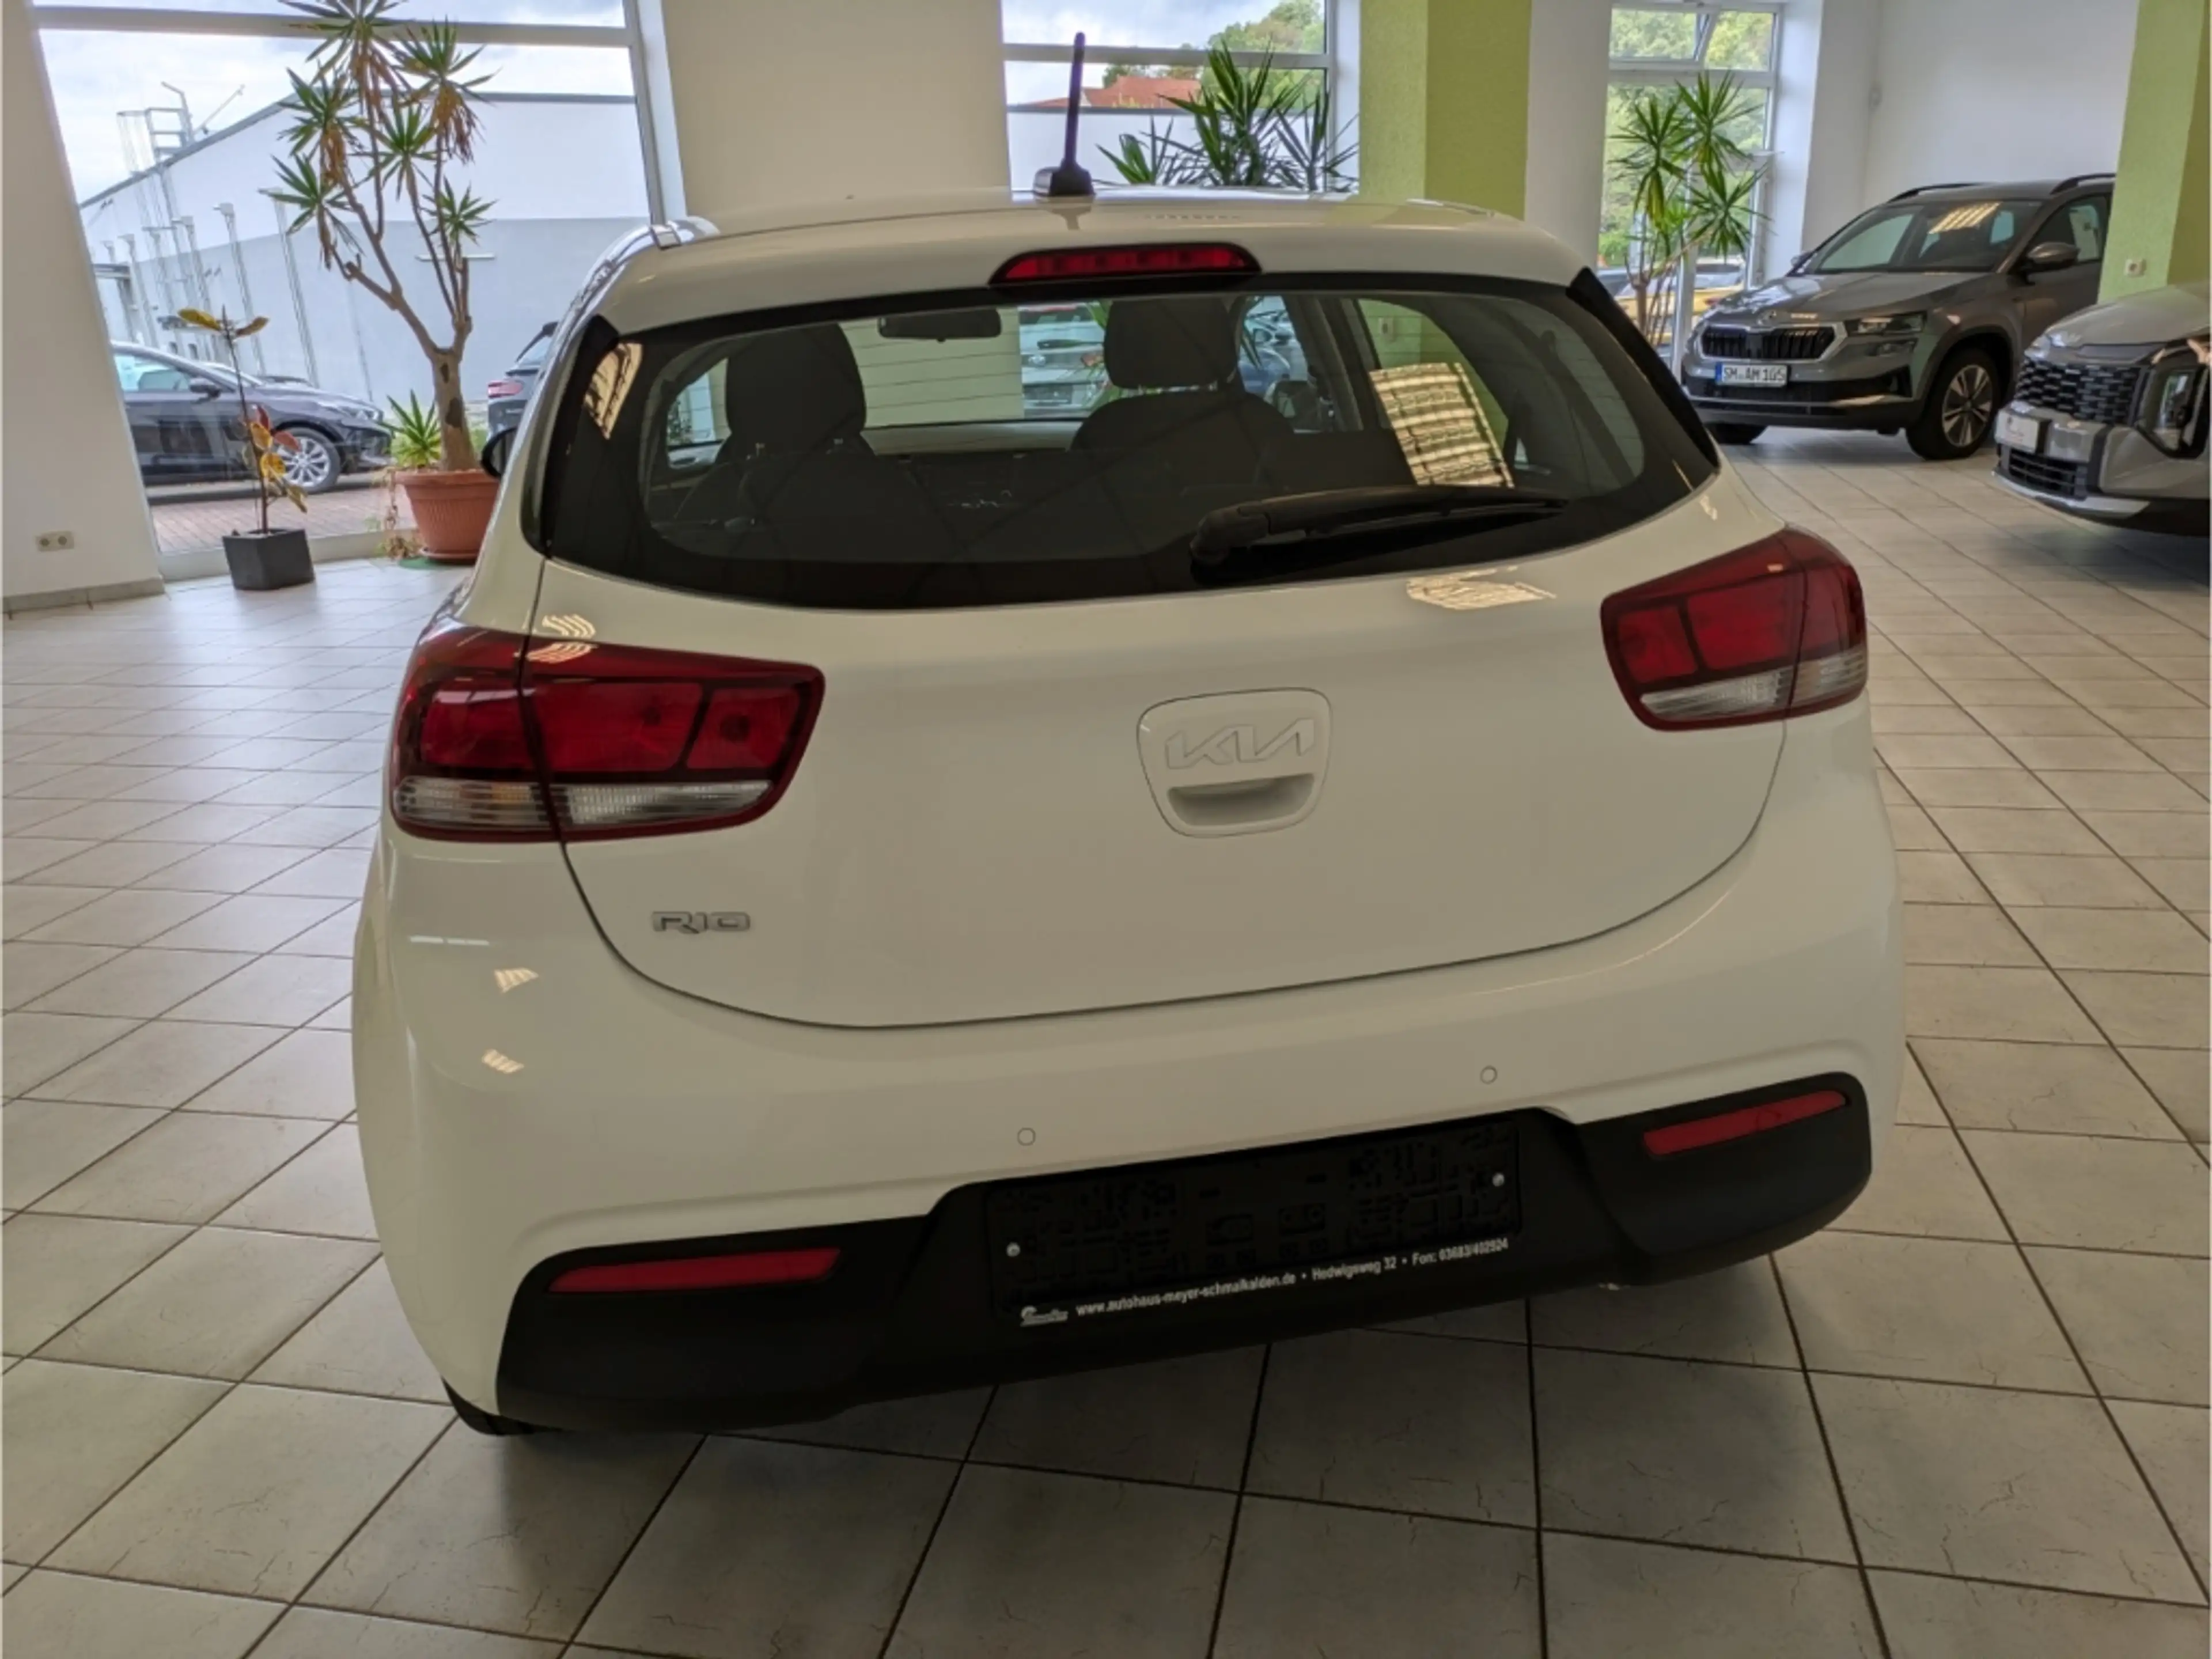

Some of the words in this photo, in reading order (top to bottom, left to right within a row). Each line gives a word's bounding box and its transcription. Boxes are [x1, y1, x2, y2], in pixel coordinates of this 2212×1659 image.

[652, 911, 751, 934] RIO
[1384, 1255, 1396, 1270] 32
[1412, 1252, 1437, 1266] Fon:
